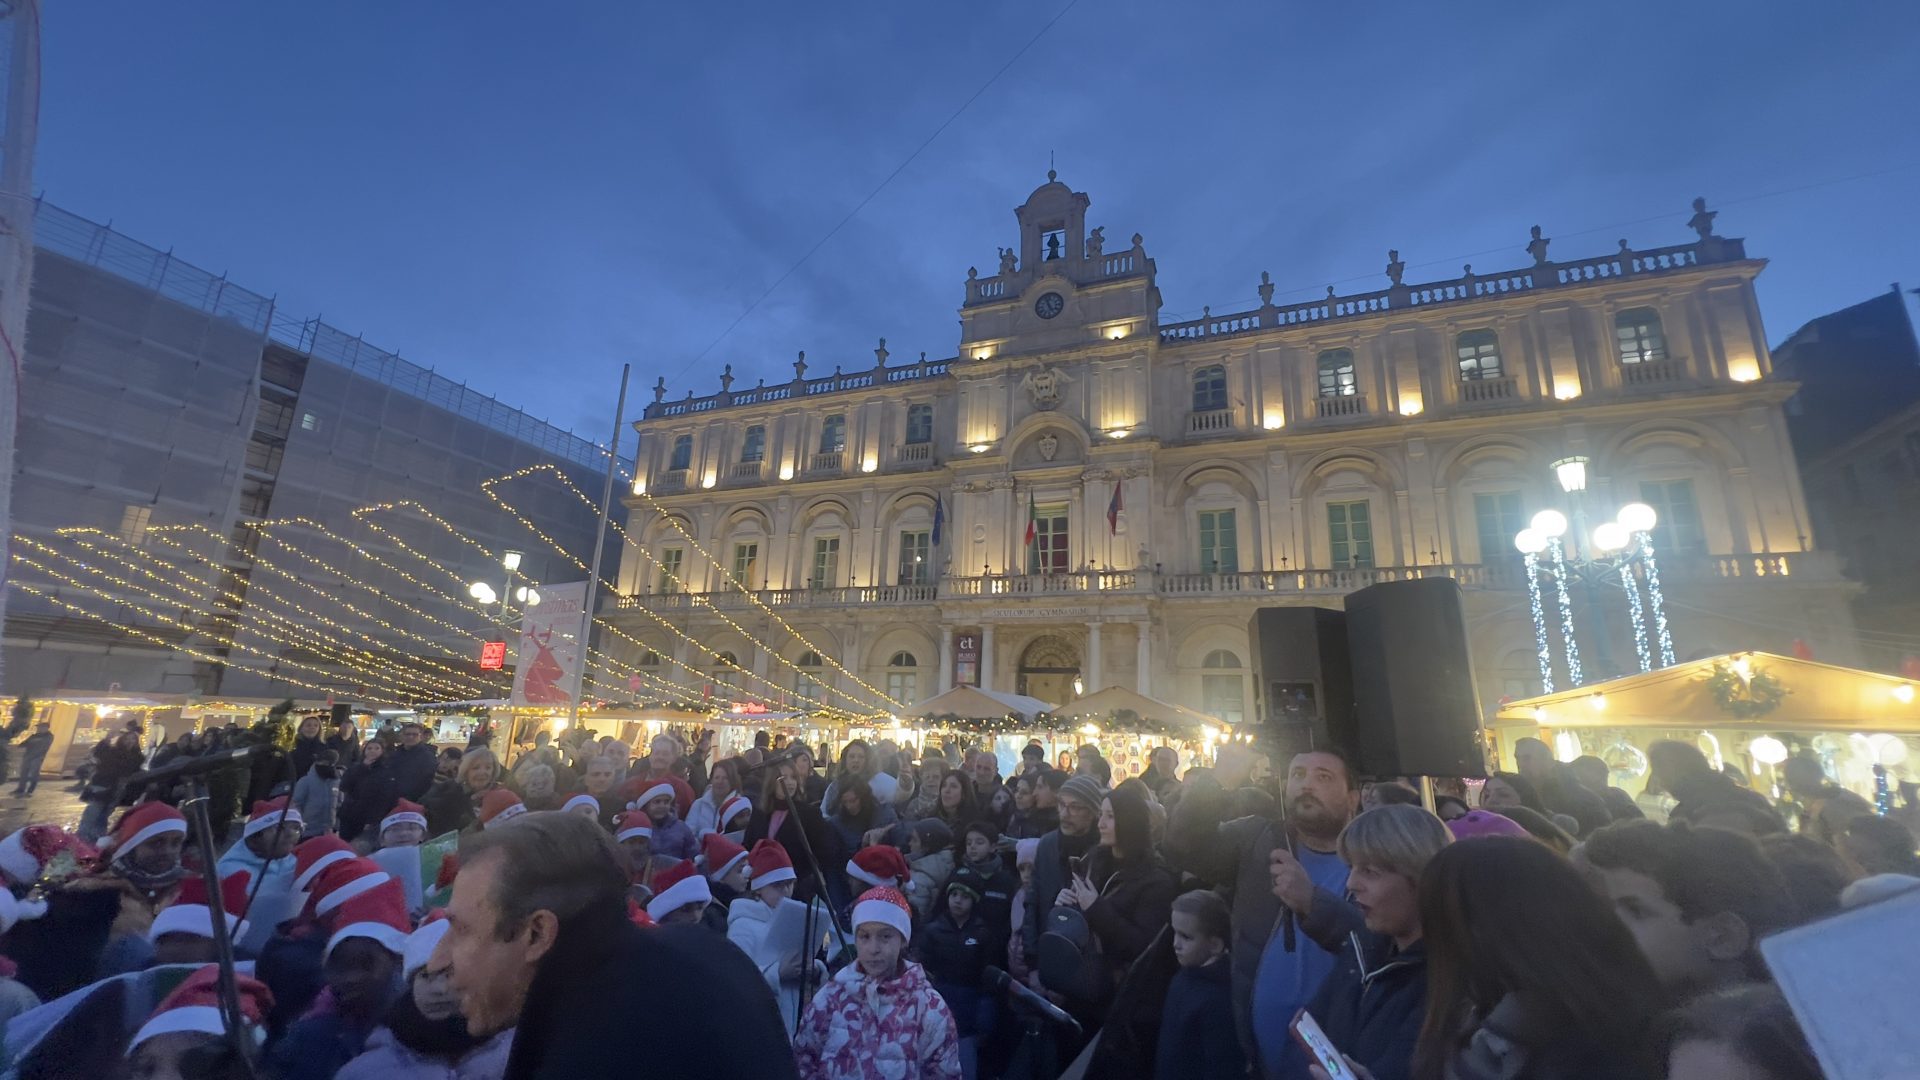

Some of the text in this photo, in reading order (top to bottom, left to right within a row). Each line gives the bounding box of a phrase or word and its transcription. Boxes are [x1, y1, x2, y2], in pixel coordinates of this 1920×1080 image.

[993, 607, 1087, 617] SICULORUM GYMNASIUM
[960, 637, 974, 650] ct
